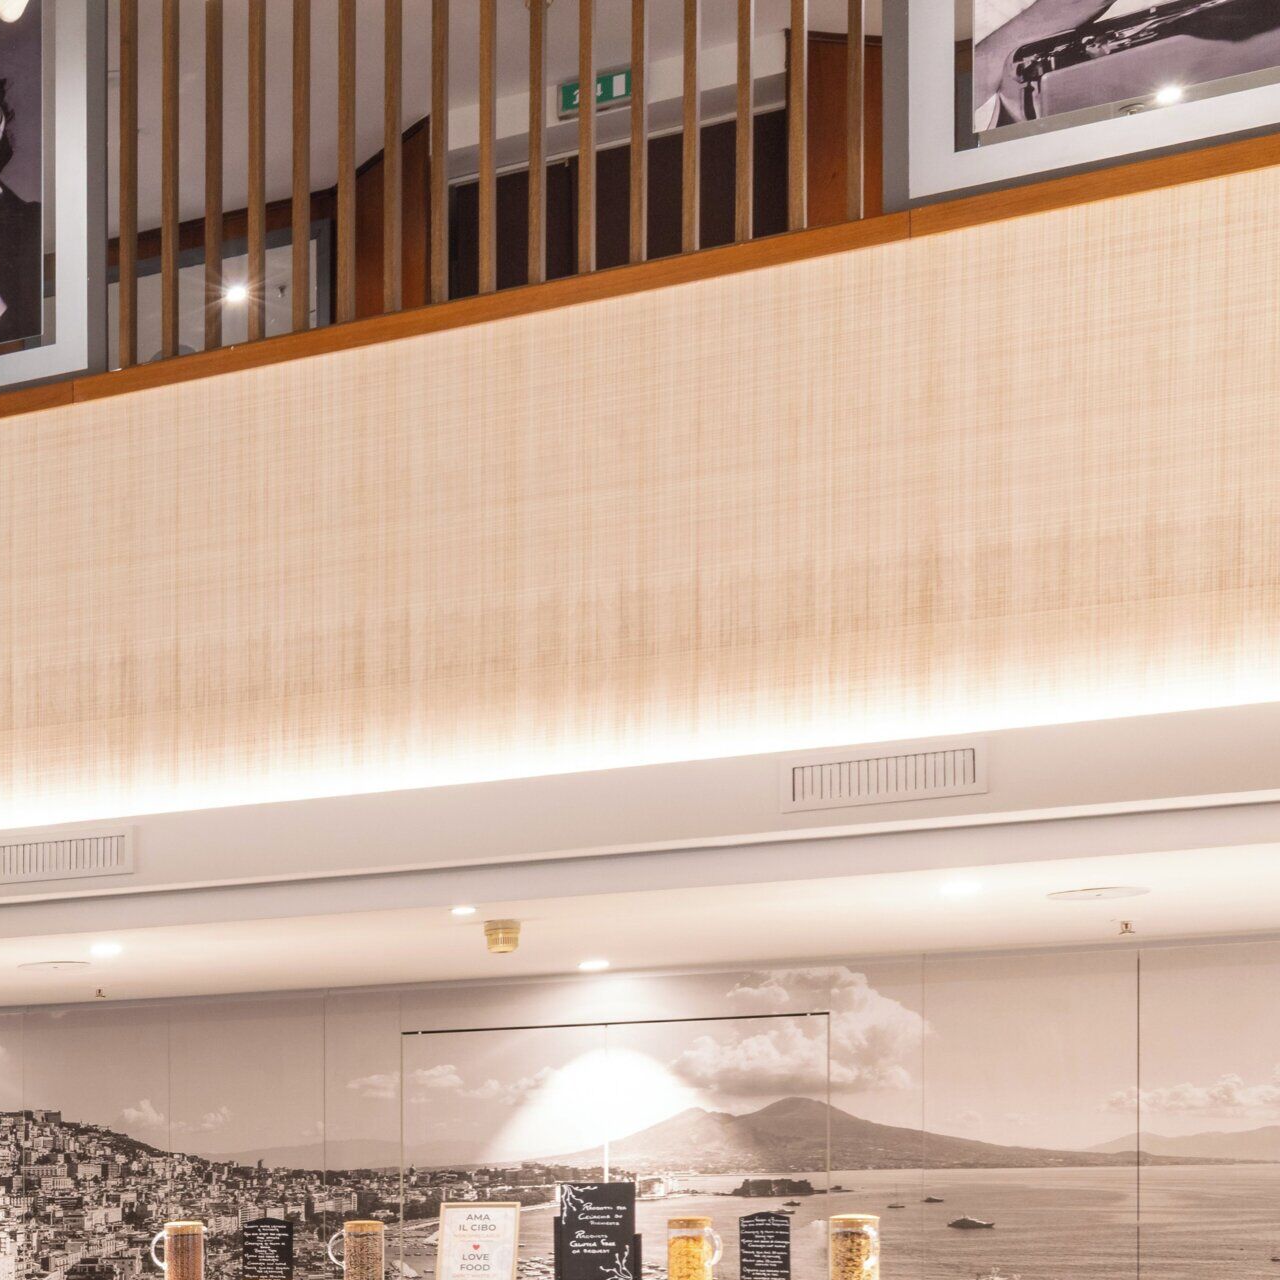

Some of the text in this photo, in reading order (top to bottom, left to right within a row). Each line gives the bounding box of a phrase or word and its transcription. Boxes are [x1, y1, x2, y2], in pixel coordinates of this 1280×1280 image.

[470, 1224, 497, 1232] CIBO
[462, 1253, 490, 1261] LOVE
[460, 1263, 491, 1271] FOOD
